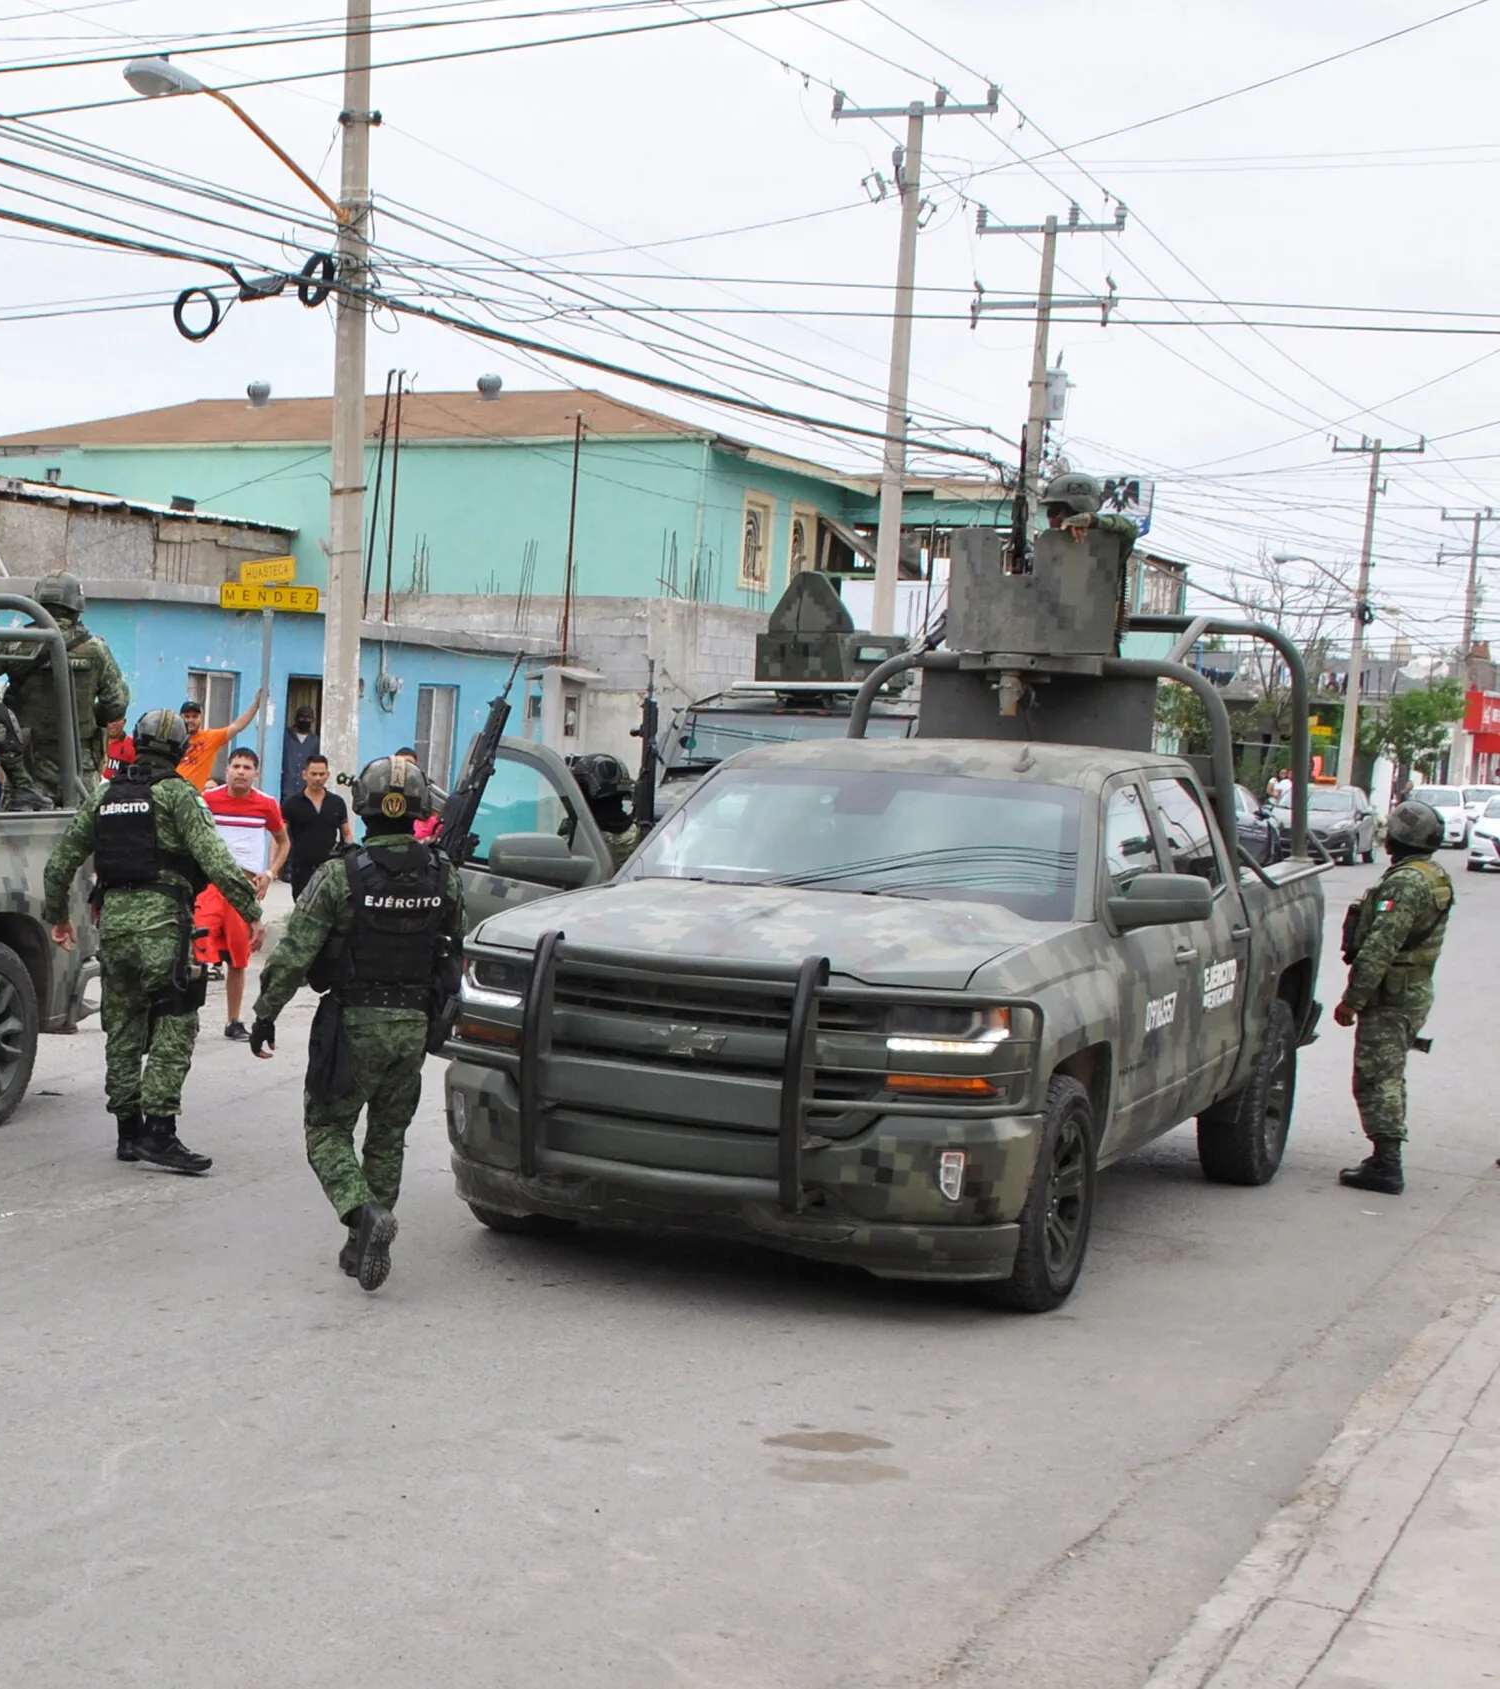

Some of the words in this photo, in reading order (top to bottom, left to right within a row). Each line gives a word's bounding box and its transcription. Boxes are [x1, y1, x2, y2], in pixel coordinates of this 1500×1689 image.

[245, 564, 289, 580] HUASTECA
[225, 589, 313, 605] MENDEZ
[100, 801, 150, 816] EJÉRCITO
[364, 894, 442, 909] EJÉRCITO
